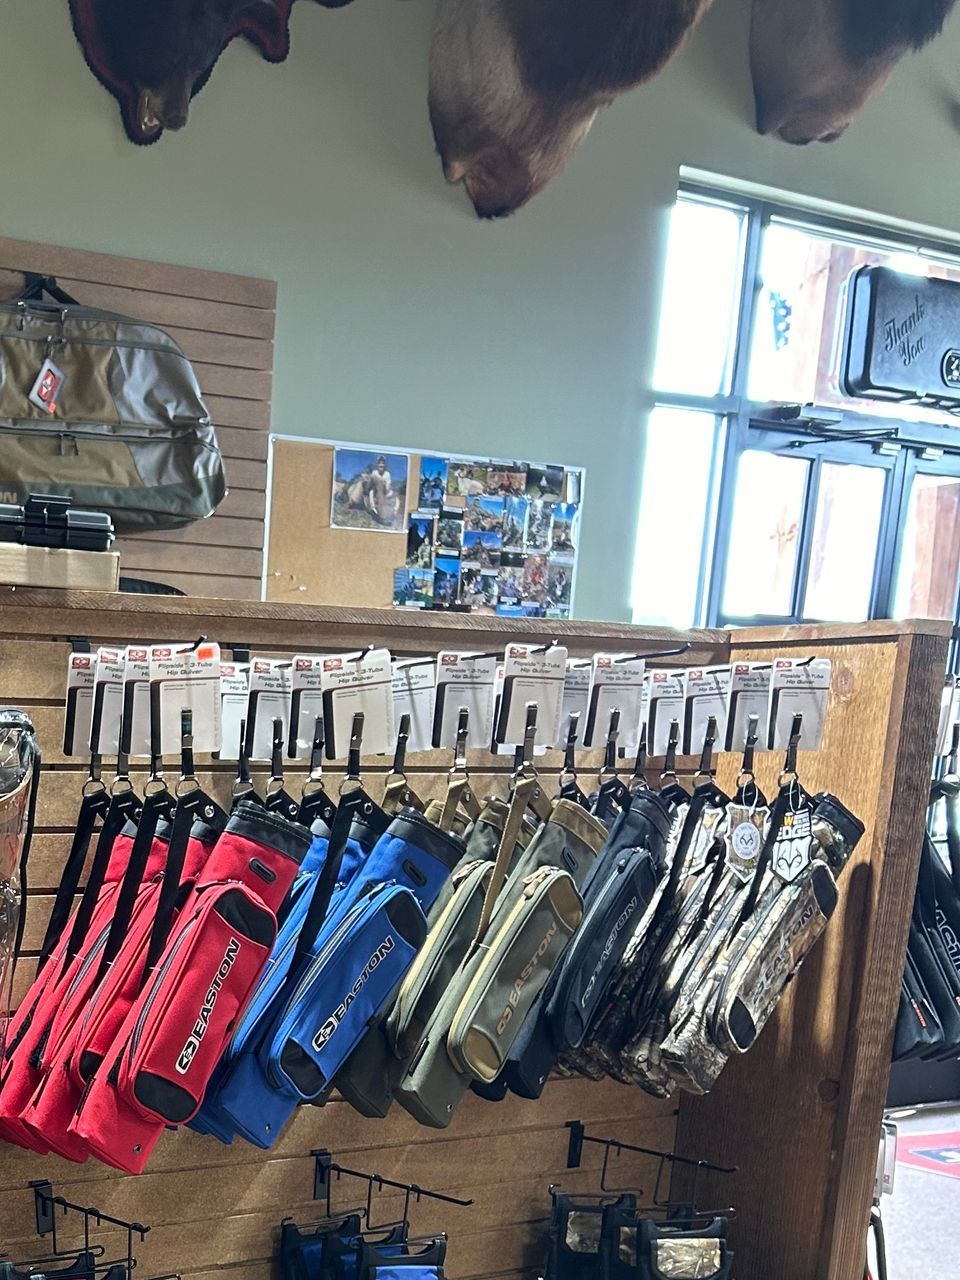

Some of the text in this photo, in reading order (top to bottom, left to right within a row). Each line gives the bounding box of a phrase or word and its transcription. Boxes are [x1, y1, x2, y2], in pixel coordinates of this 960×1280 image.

[884, 294, 925, 351] Thank
[900, 335, 925, 367] You
[191, 936, 241, 1042] EASTON
[332, 935, 395, 1025] EASTON
[508, 921, 558, 1008] EASTON
